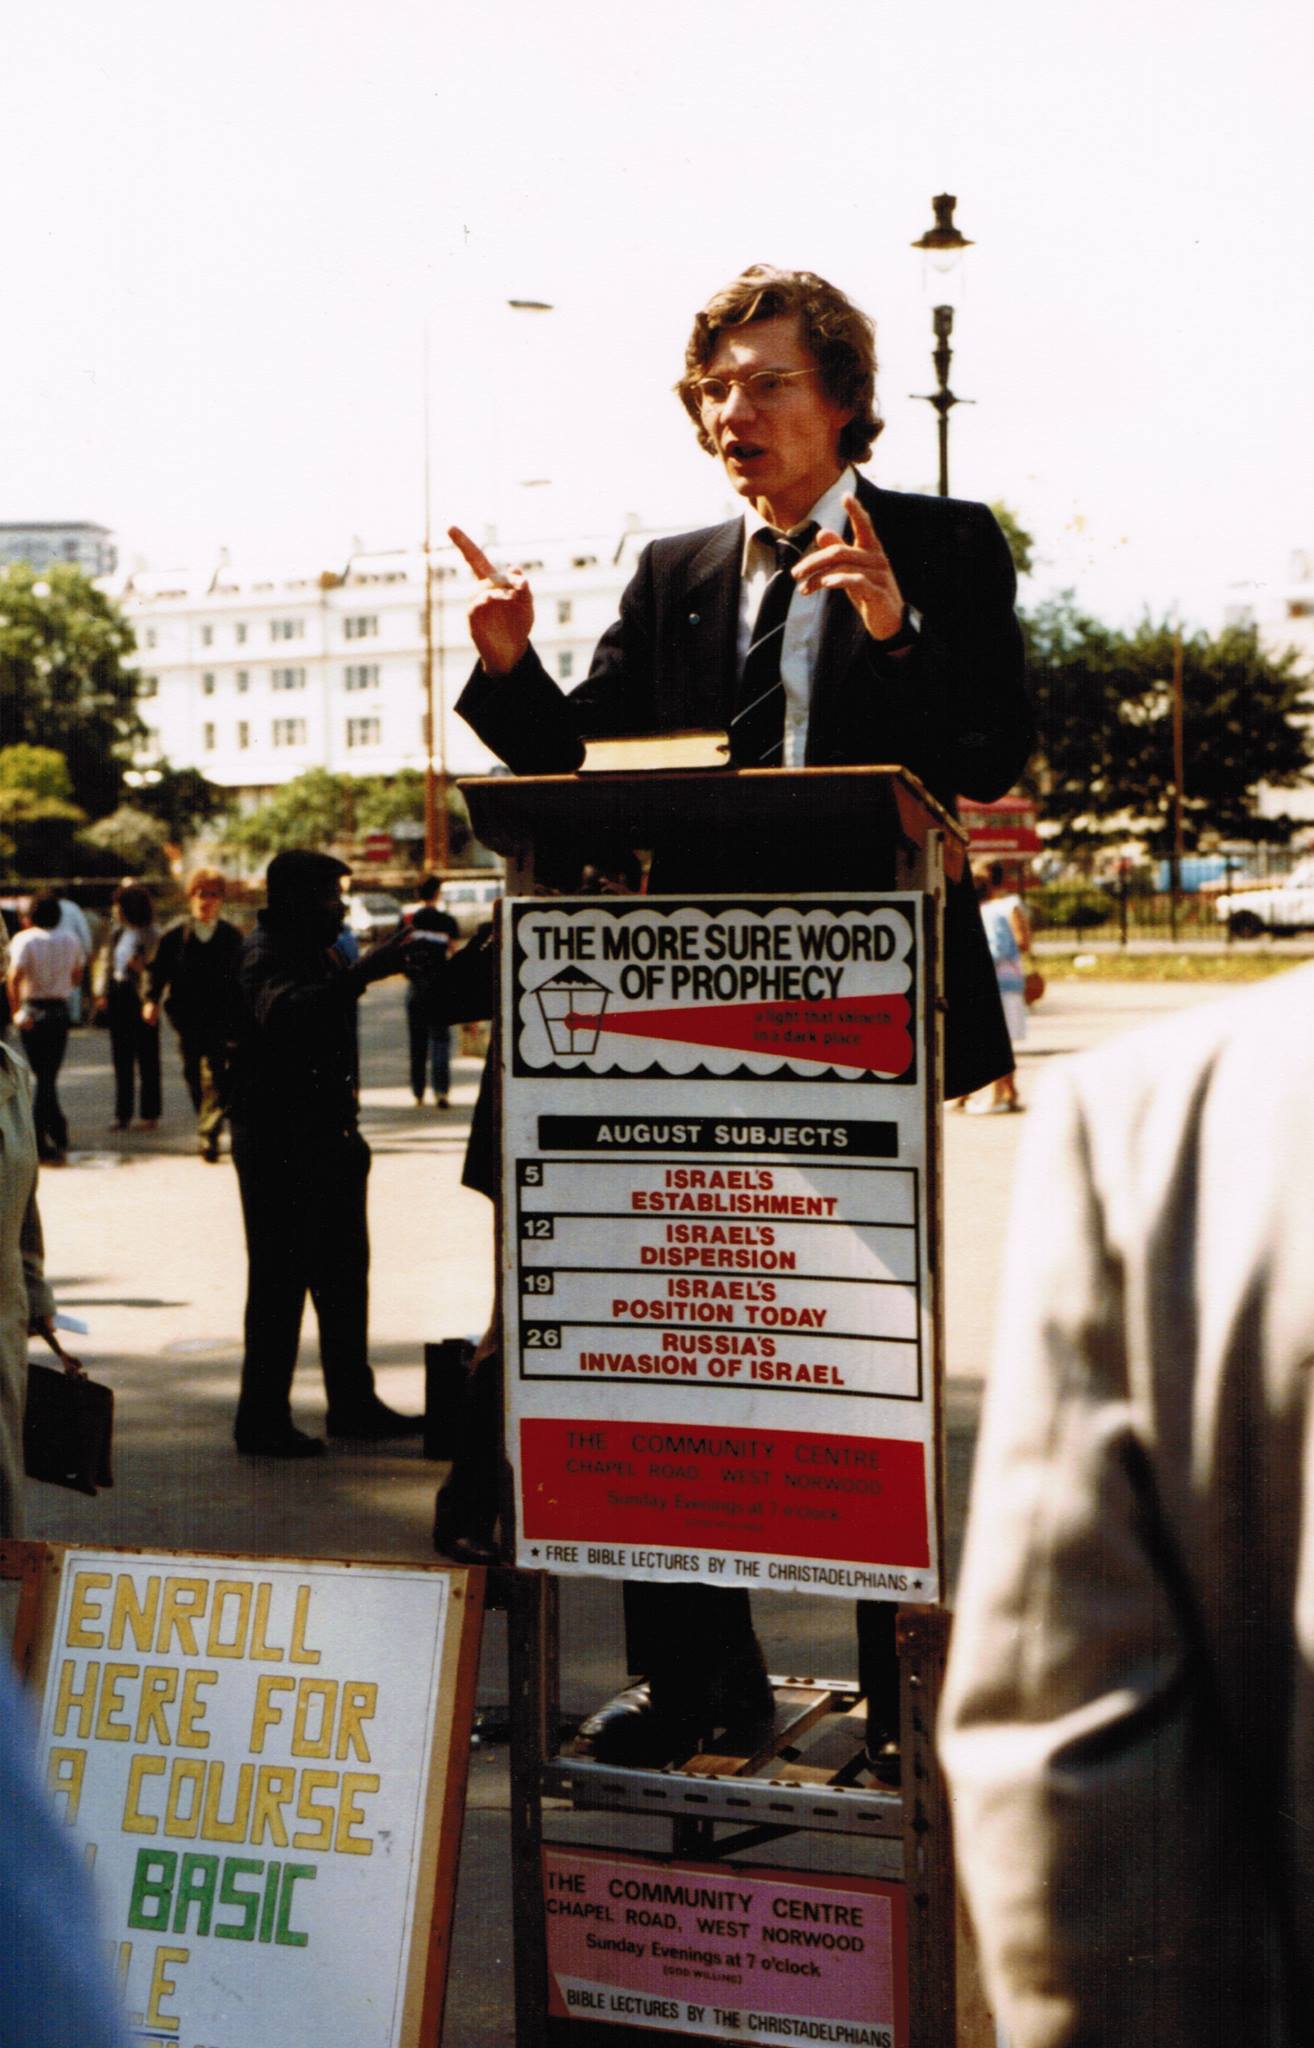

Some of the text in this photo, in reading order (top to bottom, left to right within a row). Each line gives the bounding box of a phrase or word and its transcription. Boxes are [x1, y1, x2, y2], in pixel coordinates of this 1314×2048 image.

[532, 924, 896, 961] THE MORE SURE WORD
[620, 965, 844, 1001] OF PROPHECY
[597, 1124, 848, 1147] AUGUST SUBJECTS
[524, 1166, 540, 1183] 5
[665, 1169, 774, 1190] ISRAEL'S
[631, 1191, 839, 1216] ESTABLISHMENT
[524, 1220, 551, 1237] 12
[666, 1224, 775, 1246] ISRAEL'S
[640, 1247, 796, 1270] DISPERSION
[524, 1275, 552, 1293] 19
[667, 1279, 777, 1301] ISRAEL'S
[612, 1299, 827, 1328] POSITION TODAY
[526, 1329, 559, 1347] 26
[662, 1333, 776, 1357] RUSSIA'S
[580, 1353, 845, 1386] INVASION OF ISRAEL
[566, 1431, 880, 1469] THE COMMUNITY CENTRE
[566, 1458, 637, 1477] CHAPEL
[721, 1469, 771, 1487] WEST
[784, 1472, 882, 1496] NORWOOD
[607, 1490, 667, 1511] Sunday
[675, 1494, 745, 1518] Evenings
[546, 1546, 908, 1592] FREE BIBLE LECTURES BY THE CHRISTADELPHIANS
[66, 1570, 322, 1665] ENROLL
[53, 1659, 378, 1763] HERE FOR
[122, 1754, 381, 1855] COURSE
[128, 1848, 317, 1947] BASIC
[548, 1872, 864, 1927] THE COMMUNITY CENTRE
[546, 1898, 615, 1923] CHAPEL
[697, 1917, 750, 1938] WEST
[762, 1926, 865, 1952] NORWOOD
[585, 1934, 822, 1978] Sunday Evenings at 7 o'clock
[567, 1989, 892, 2048] BIBLE LECTURES BY THE CHRISTADELPHIANS
